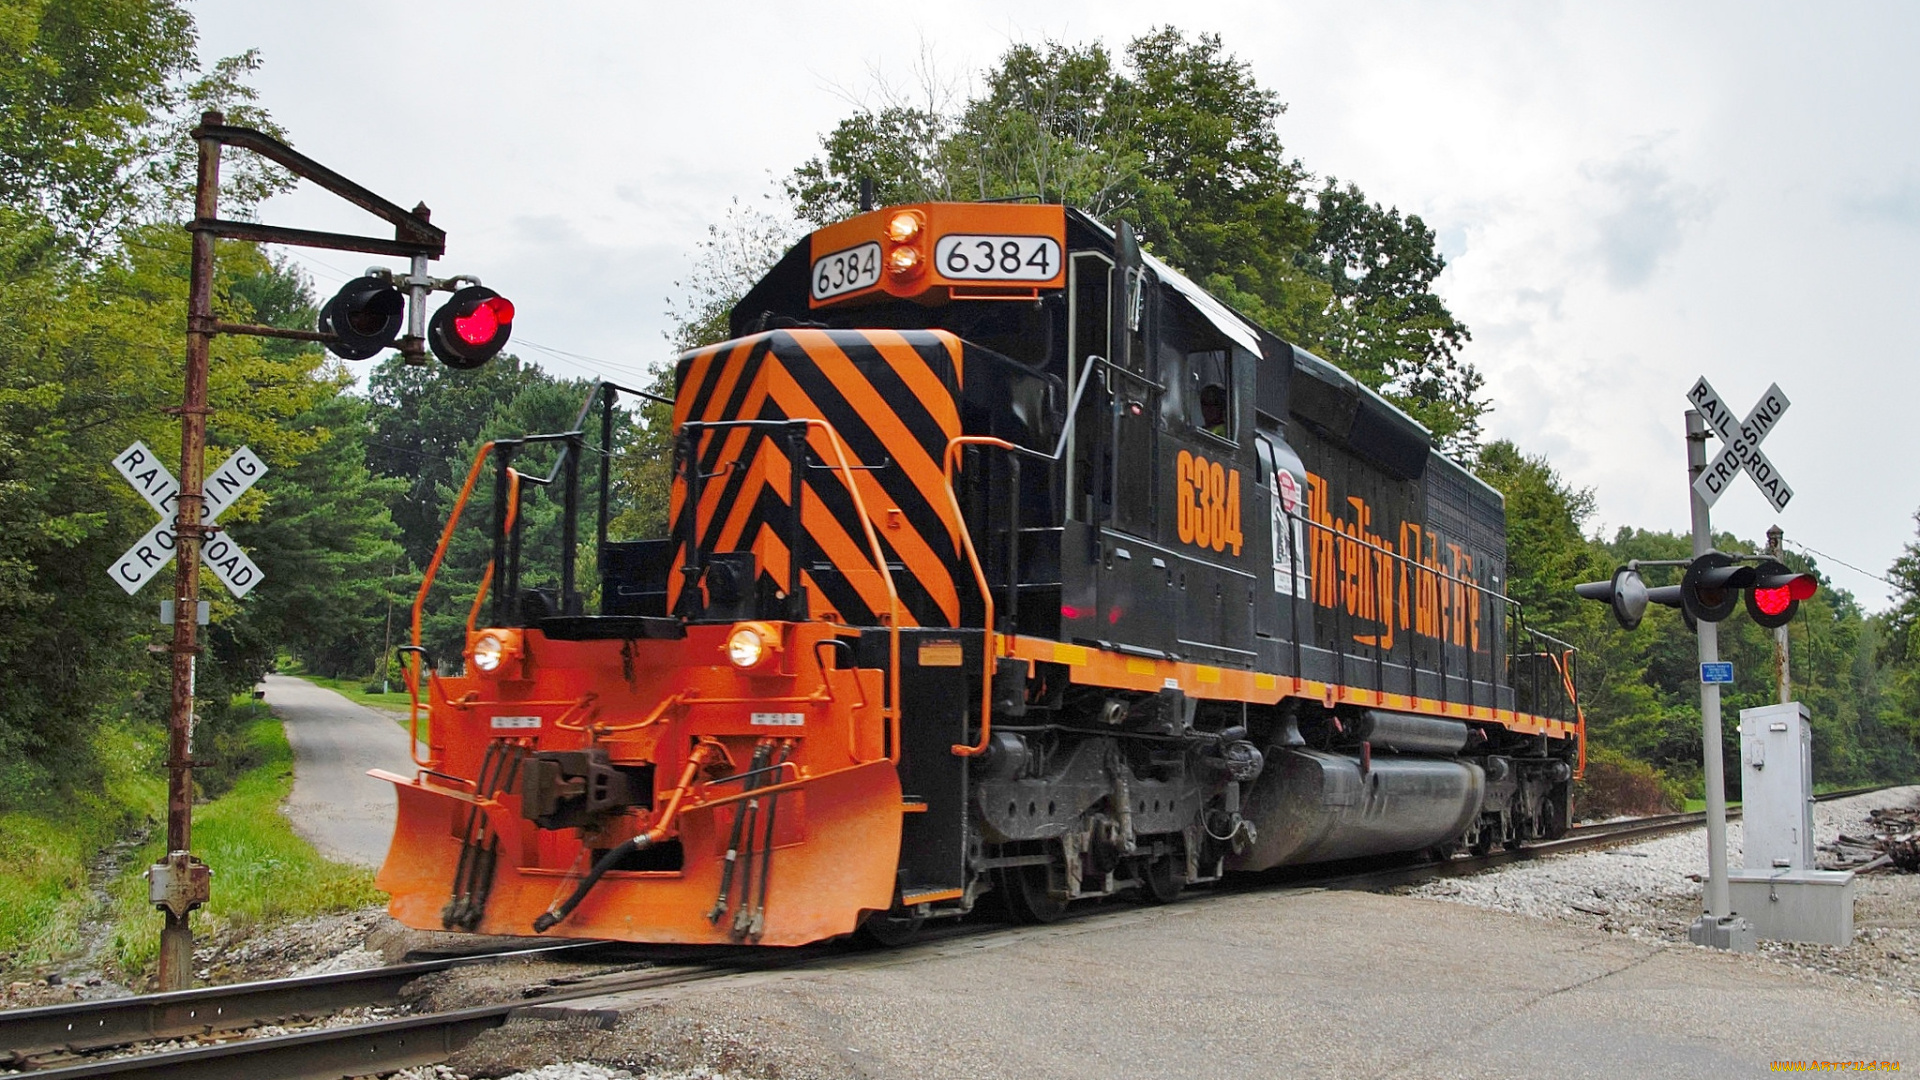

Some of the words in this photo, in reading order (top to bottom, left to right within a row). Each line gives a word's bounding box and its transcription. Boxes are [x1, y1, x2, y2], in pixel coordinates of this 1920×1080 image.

[818, 247, 875, 294] 6384
[946, 240, 1050, 275] 6384
[1692, 382, 1730, 438] RAIL
[1747, 451, 1791, 508] ROAD
[1704, 395, 1781, 494] CROSSING
[1176, 449, 1244, 557] 6384
[1399, 520, 1410, 630] &
[1408, 523, 1449, 642] Lake
